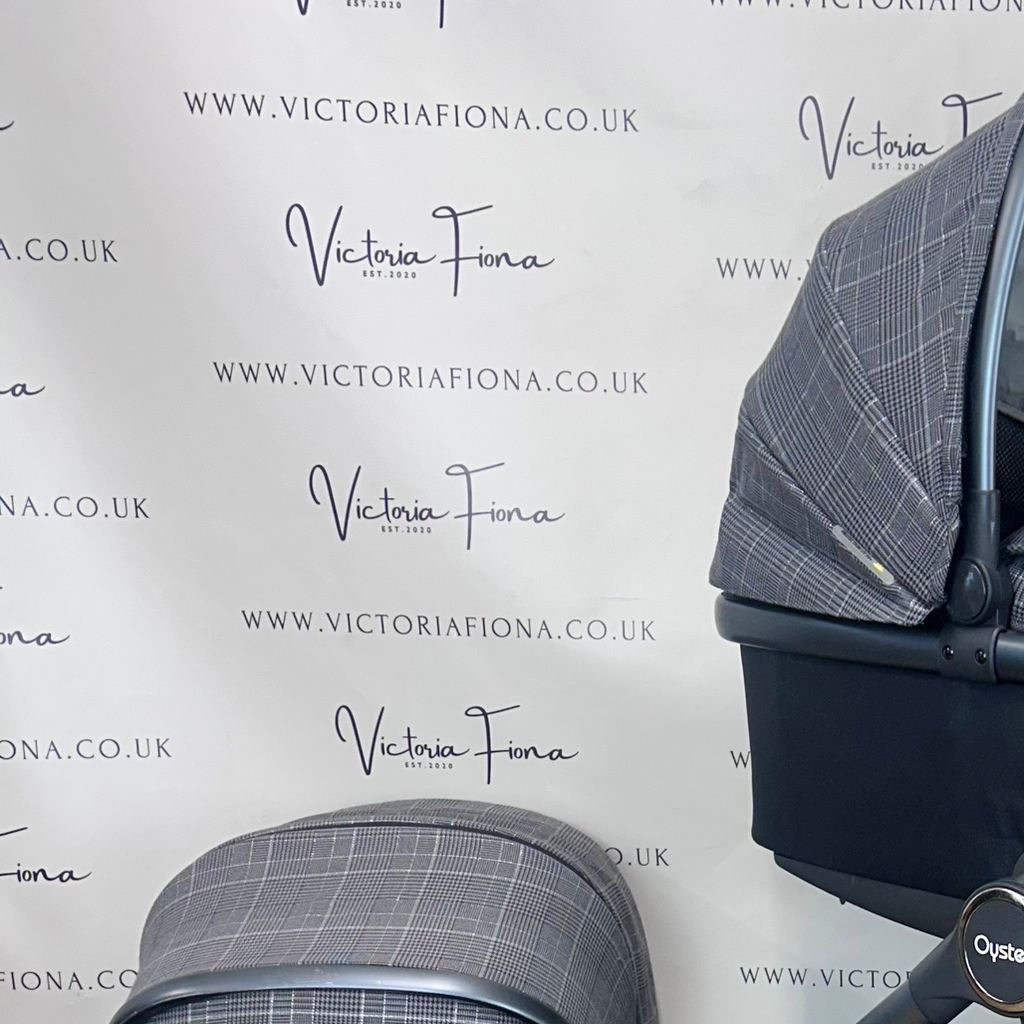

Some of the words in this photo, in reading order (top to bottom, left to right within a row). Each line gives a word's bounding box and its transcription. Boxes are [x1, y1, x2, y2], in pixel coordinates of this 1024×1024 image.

[184, 92, 638, 132] WWW.VICTORIAFIONA.CO.UK
[799, 95, 943, 181] Victoria
[285, 203, 437, 286] Victoria
[432, 205, 555, 297] Fiona
[363, 271, 417, 279] EST.2020
[213, 362, 647, 393] WWW.VICTORIAFIONA.CO.UK
[309, 464, 450, 541] Victoria
[445, 462, 566, 550] Fiona
[381, 525, 432, 534] EST.2020
[241, 610, 655, 640] WWW.VICTORIAFIONA.CO.UK
[335, 705, 470, 776] Victoria
[464, 705, 579, 785] Fiona
[404, 761, 454, 770] EST.2020
